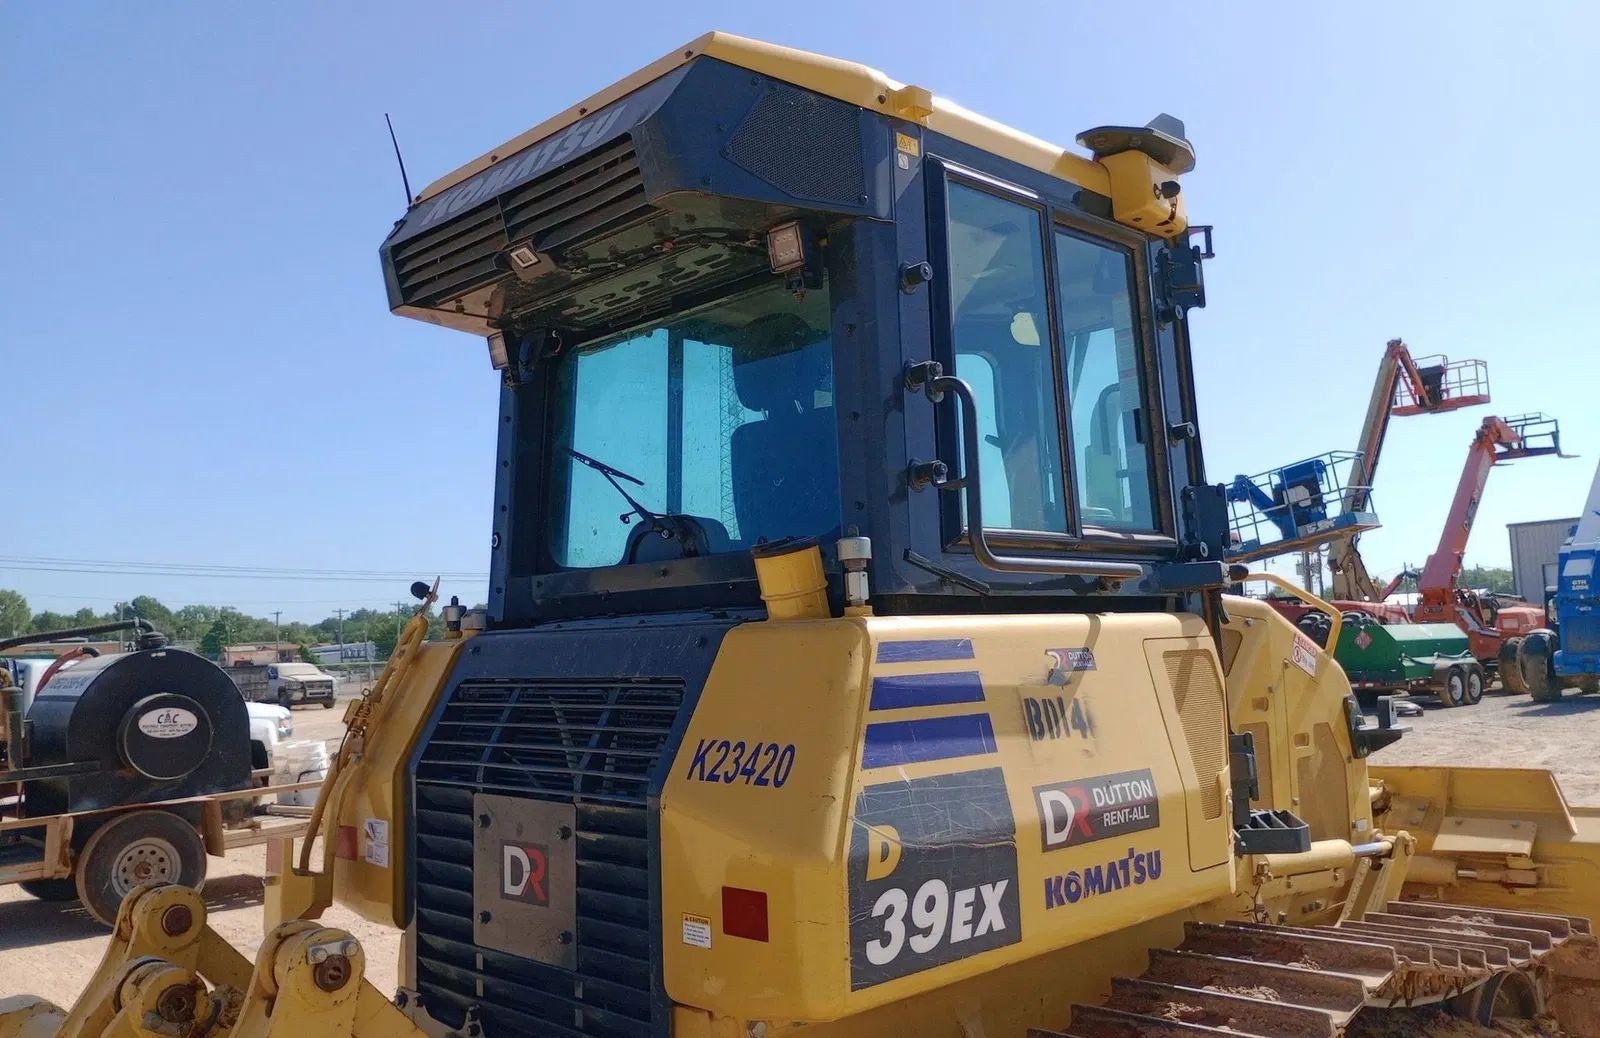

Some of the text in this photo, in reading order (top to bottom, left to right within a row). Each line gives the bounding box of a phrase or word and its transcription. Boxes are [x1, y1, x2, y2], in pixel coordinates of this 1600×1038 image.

[420, 104, 627, 228] KOMATSU
[686, 738, 796, 788] K23420
[1039, 783, 1094, 846] DR
[1092, 779, 1153, 807] DUTTON
[1103, 805, 1150, 827] RENT-ALL
[503, 844, 547, 901] DR
[865, 824, 903, 882] D
[1044, 847, 1162, 910] KOMATSU
[865, 878, 1009, 966] 39EX
